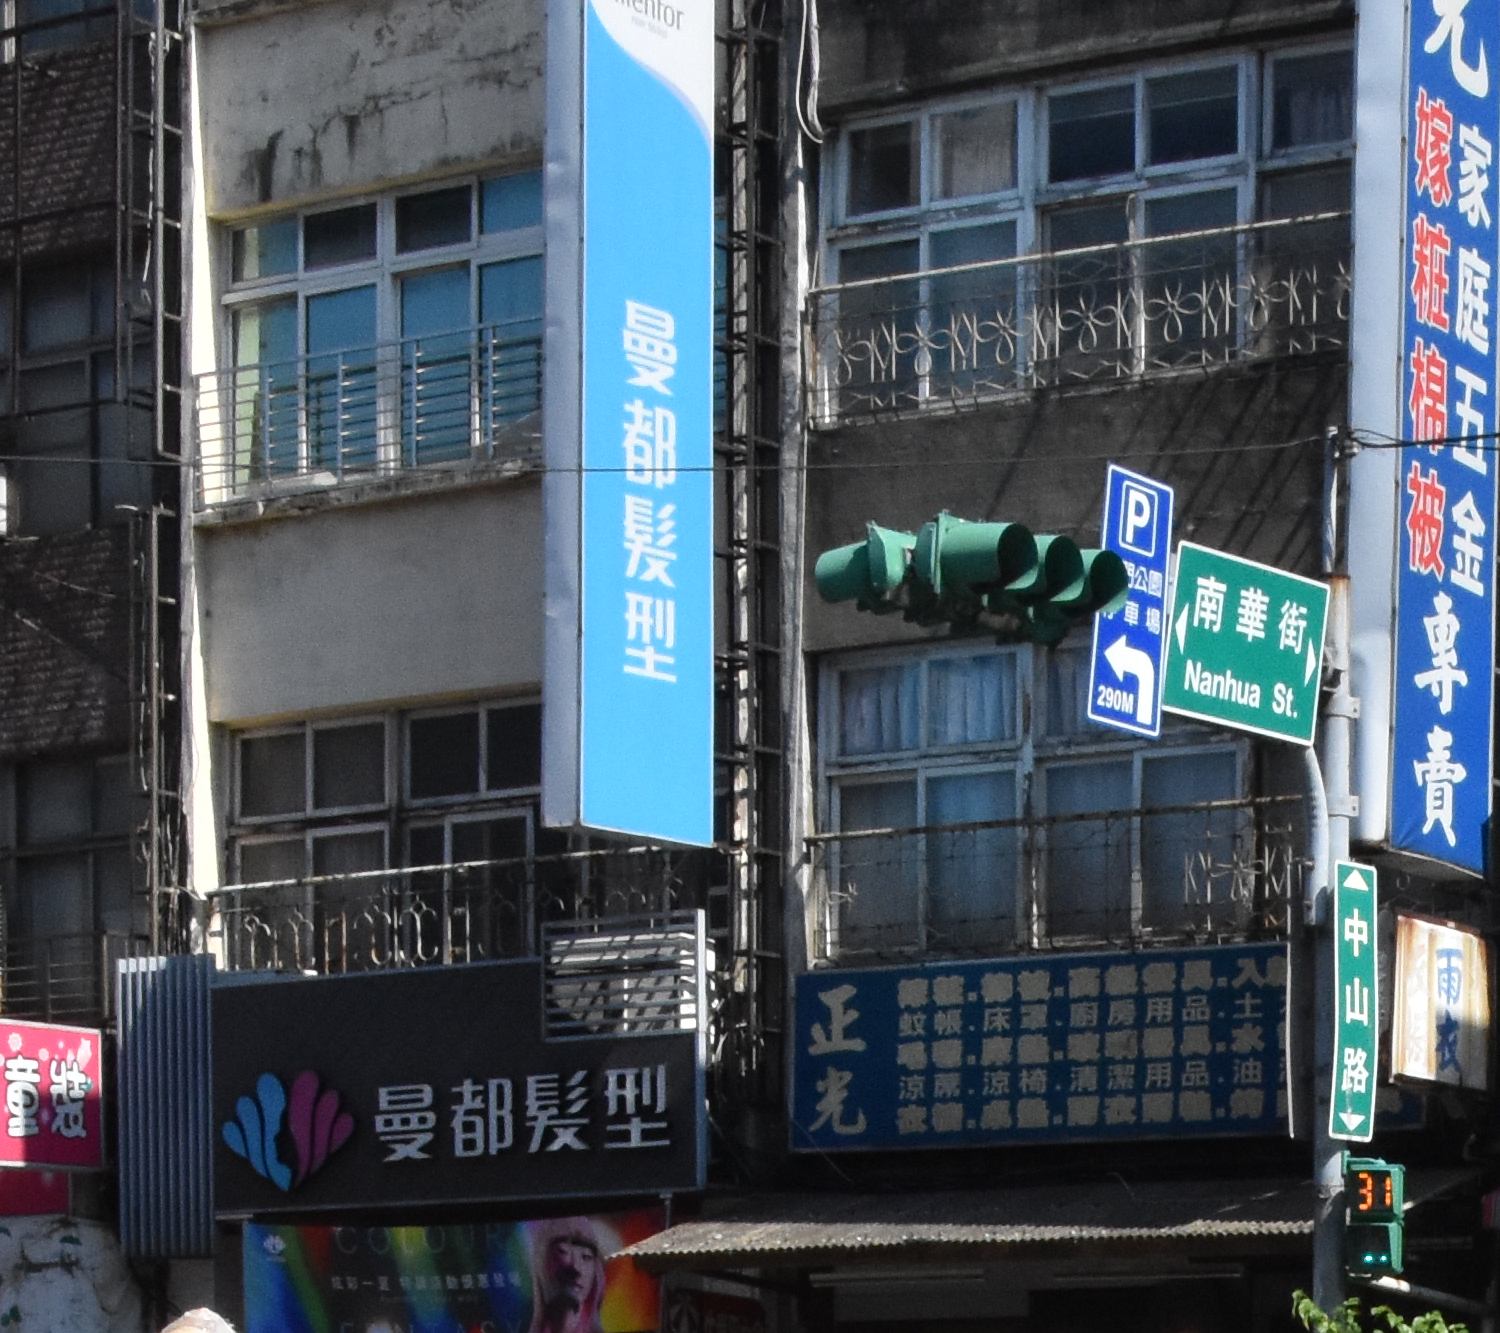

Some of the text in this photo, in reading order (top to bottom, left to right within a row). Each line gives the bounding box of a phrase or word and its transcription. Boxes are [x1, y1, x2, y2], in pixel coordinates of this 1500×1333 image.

[1406, 86, 1453, 582] 嫁粧棉被
[1449, 125, 1492, 598] 家庭五金
[623, 300, 679, 682] 曼都髮型
[1125, 489, 1150, 543] P
[1192, 576, 1307, 655] 南華街
[1096, 684, 1134, 715] 290M
[1184, 659, 1298, 719] Nanhua St.
[1413, 591, 1468, 847] 專賣
[808, 984, 867, 1138] 正光
[1342, 908, 1371, 1096] 中山路
[374, 1064, 671, 1163] 曼都髮型
[1358, 1172, 1392, 1212] 31
